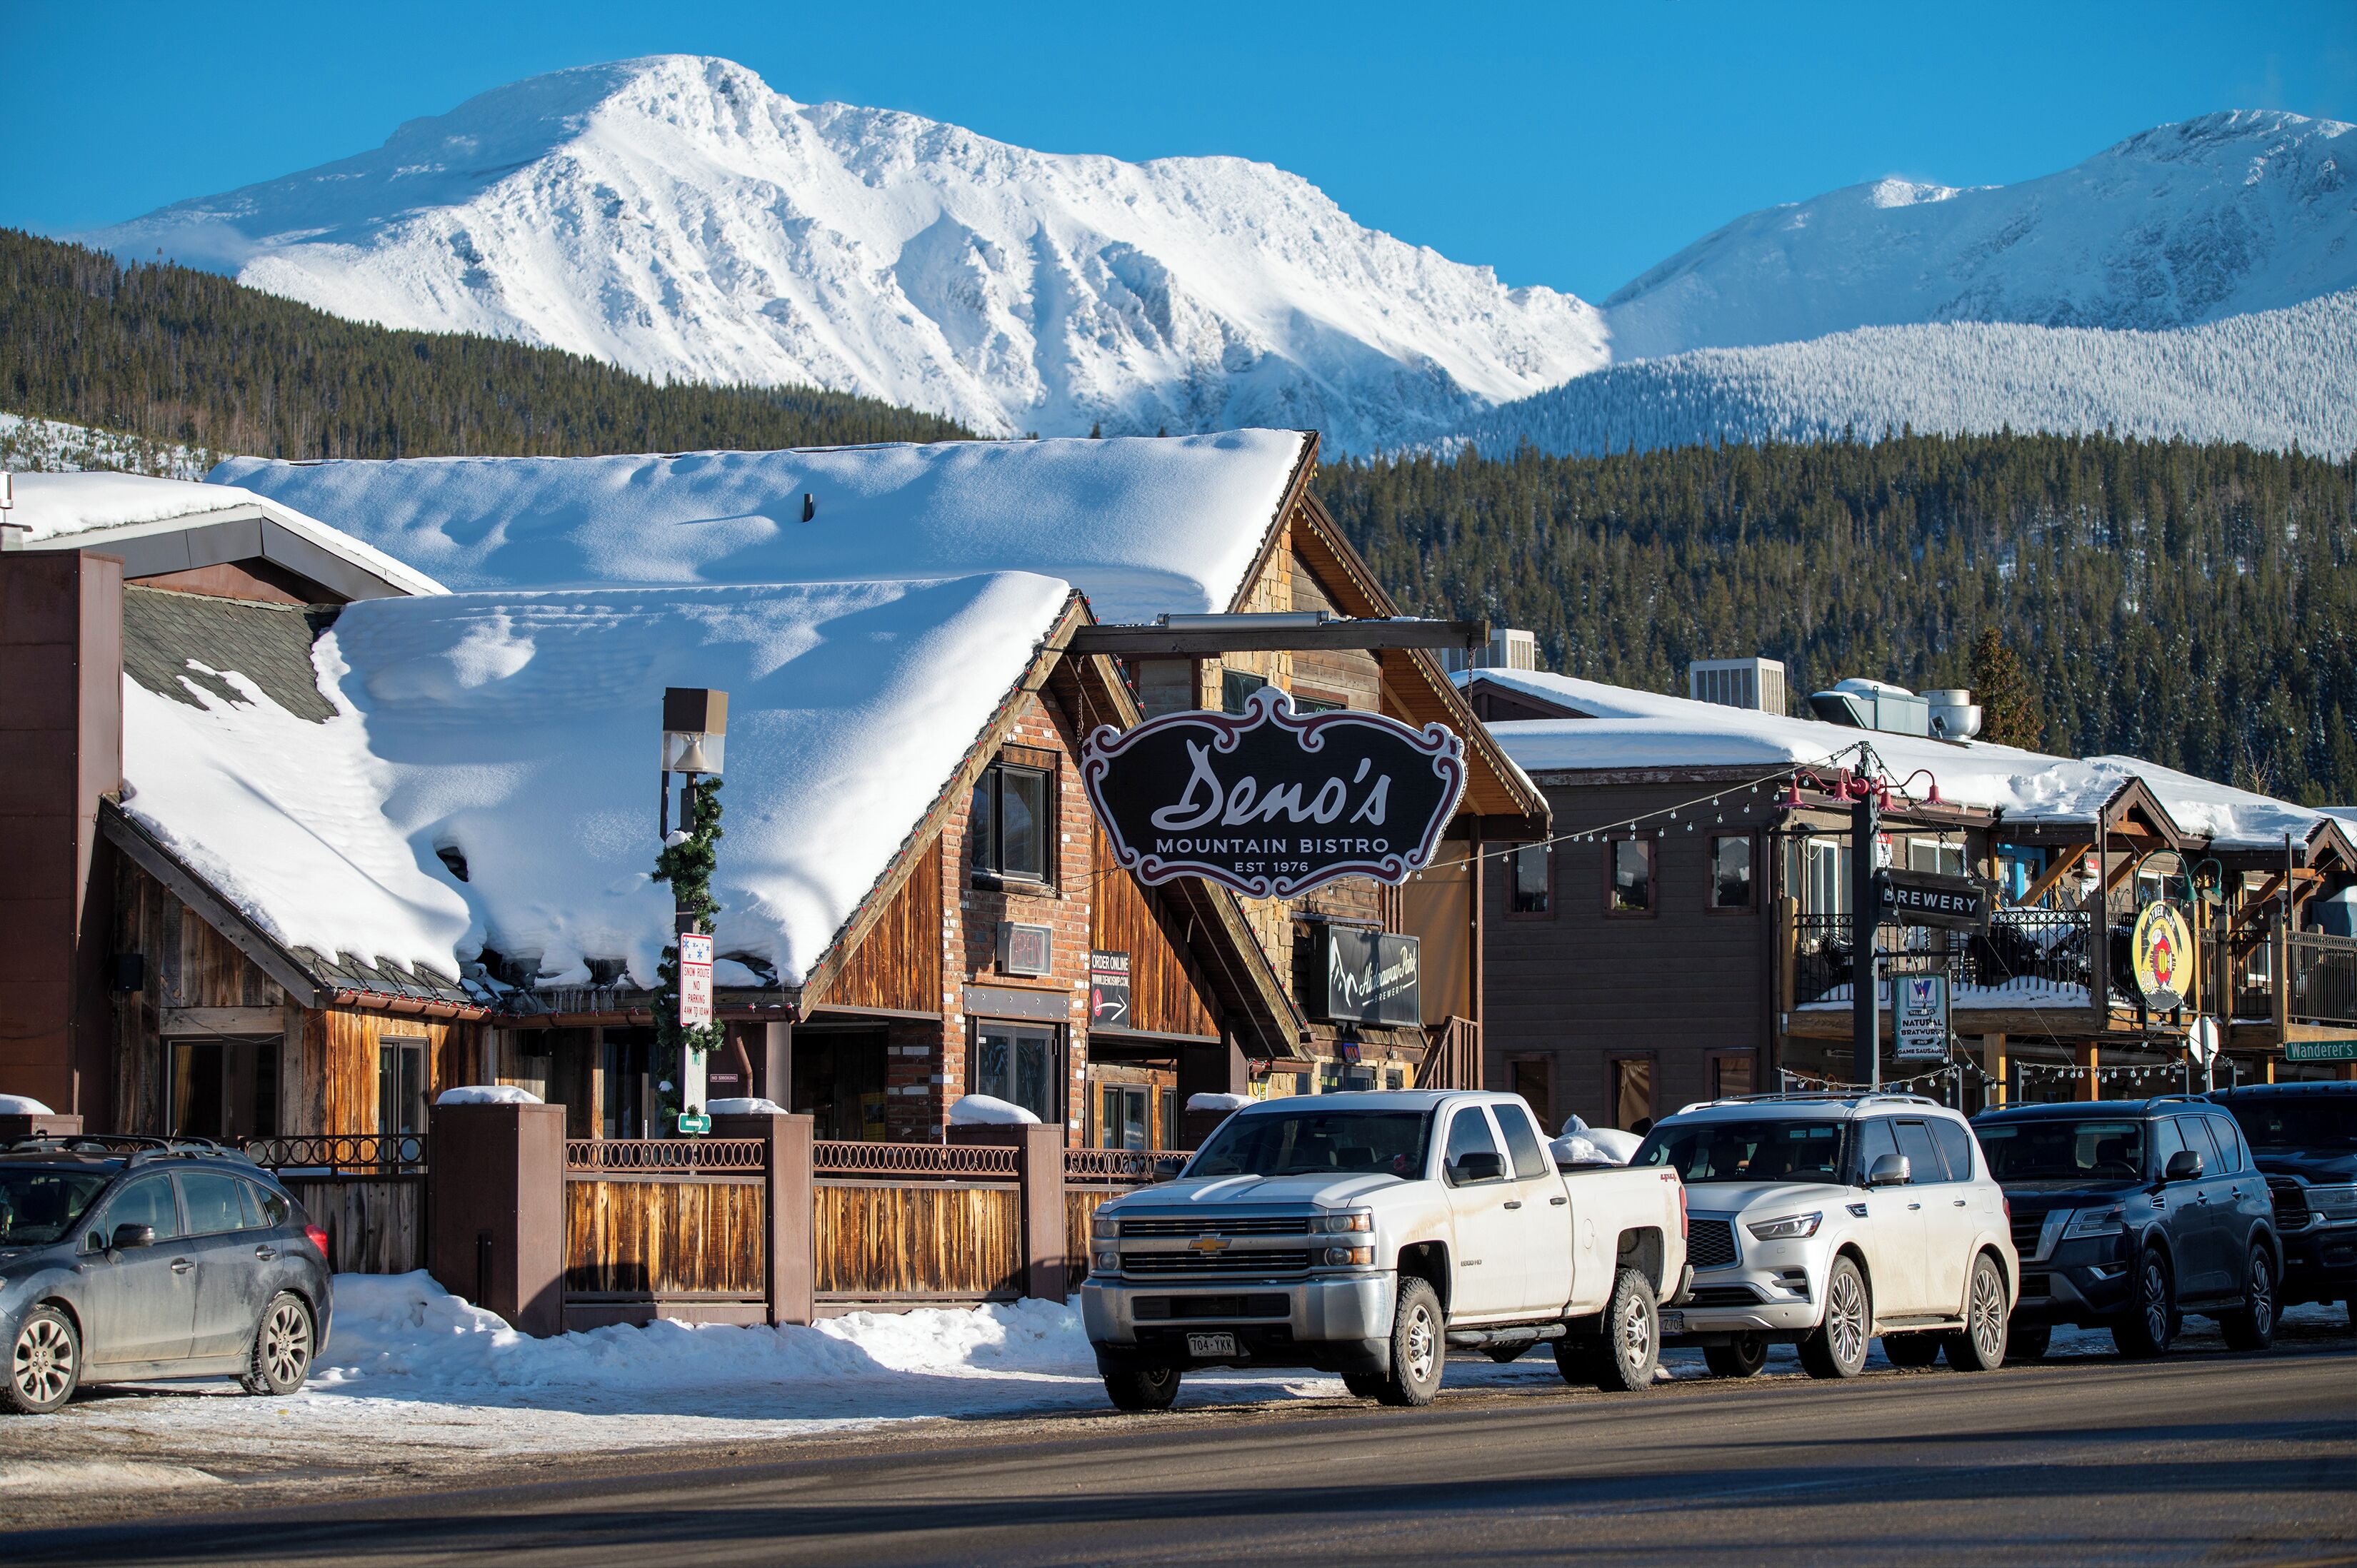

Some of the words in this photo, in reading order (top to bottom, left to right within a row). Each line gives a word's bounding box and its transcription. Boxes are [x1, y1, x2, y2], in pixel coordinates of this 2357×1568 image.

[1151, 739, 1391, 830] Deno's
[1156, 838, 1286, 853] MOUNTAIN
[1300, 838, 1389, 853] BISTRO
[1234, 862, 1266, 873] EST
[1273, 862, 1309, 873] 1976
[1883, 888, 1977, 913] BREWERY
[2148, 905, 2164, 925] OTHER
[1011, 933, 1043, 965] OPEN
[1092, 955, 1109, 970] ORDER
[1110, 956, 1129, 971] ONLINE
[1358, 961, 1401, 997] Hideaway
[1399, 945, 1417, 979] Park
[684, 967, 695, 978] SNOW
[696, 968, 710, 978] ROUTE
[2141, 970, 2156, 990] BAR
[693, 980, 701, 990] NO
[1374, 985, 1403, 1002] BREWERY
[687, 993, 706, 1005] PARKING
[694, 1007, 699, 1015] TO
[2291, 1041, 2353, 1058] Wanderer's
